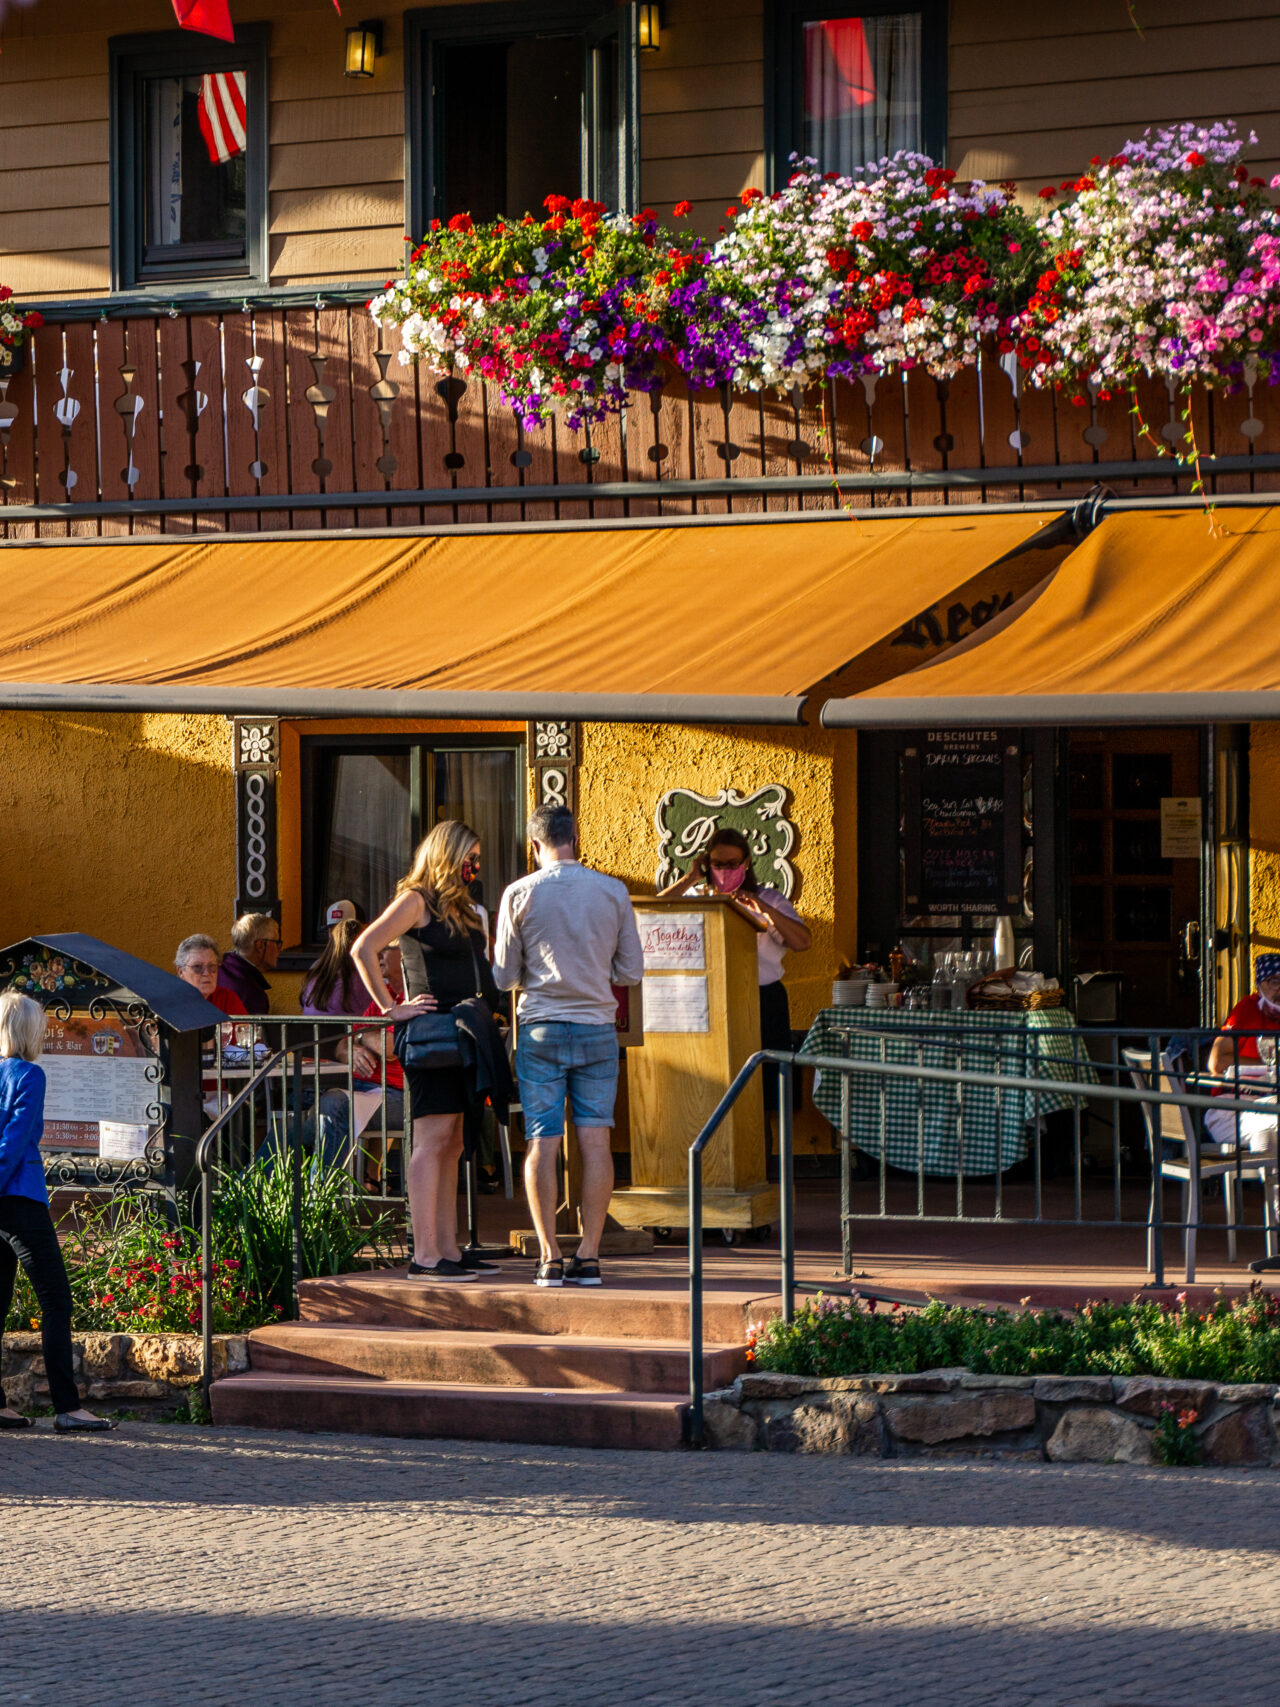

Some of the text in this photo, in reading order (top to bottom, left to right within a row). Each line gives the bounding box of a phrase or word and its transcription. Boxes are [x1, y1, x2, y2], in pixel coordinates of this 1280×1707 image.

[927, 731, 998, 742] DESCHUTES
[943, 743, 981, 751] BREWERY
[674, 814, 769, 858] P's
[928, 903, 960, 912] WORTH
[651, 926, 701, 946] Together
[44, 1025, 65, 1040] pi's
[65, 1040, 83, 1051] Bar
